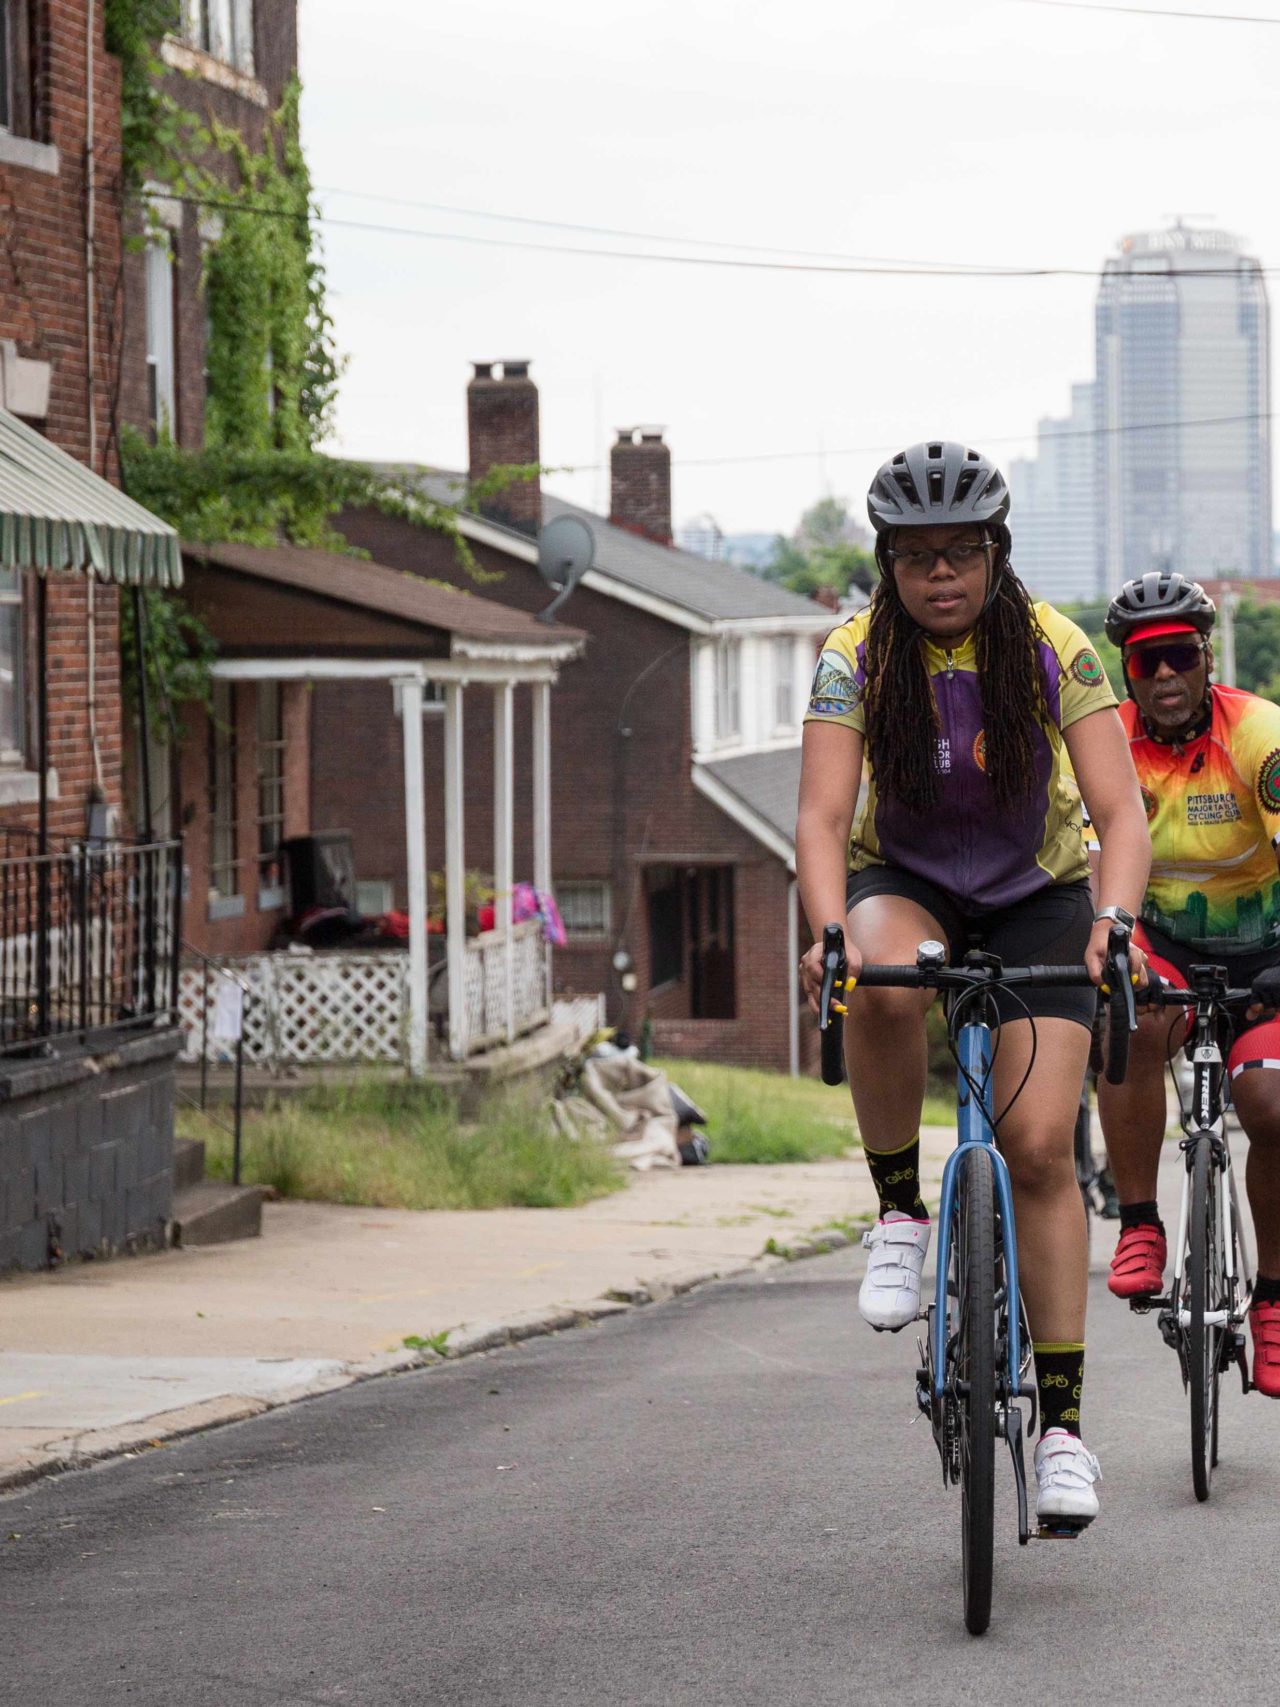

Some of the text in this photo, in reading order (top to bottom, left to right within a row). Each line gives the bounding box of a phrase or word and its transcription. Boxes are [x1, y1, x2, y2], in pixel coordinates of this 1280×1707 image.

[1187, 793, 1236, 805] PITTSBURGH
[1187, 804, 1213, 813] MAJOR
[1187, 811, 1222, 821] CYCLING
[1201, 1068, 1210, 1119] TREK
